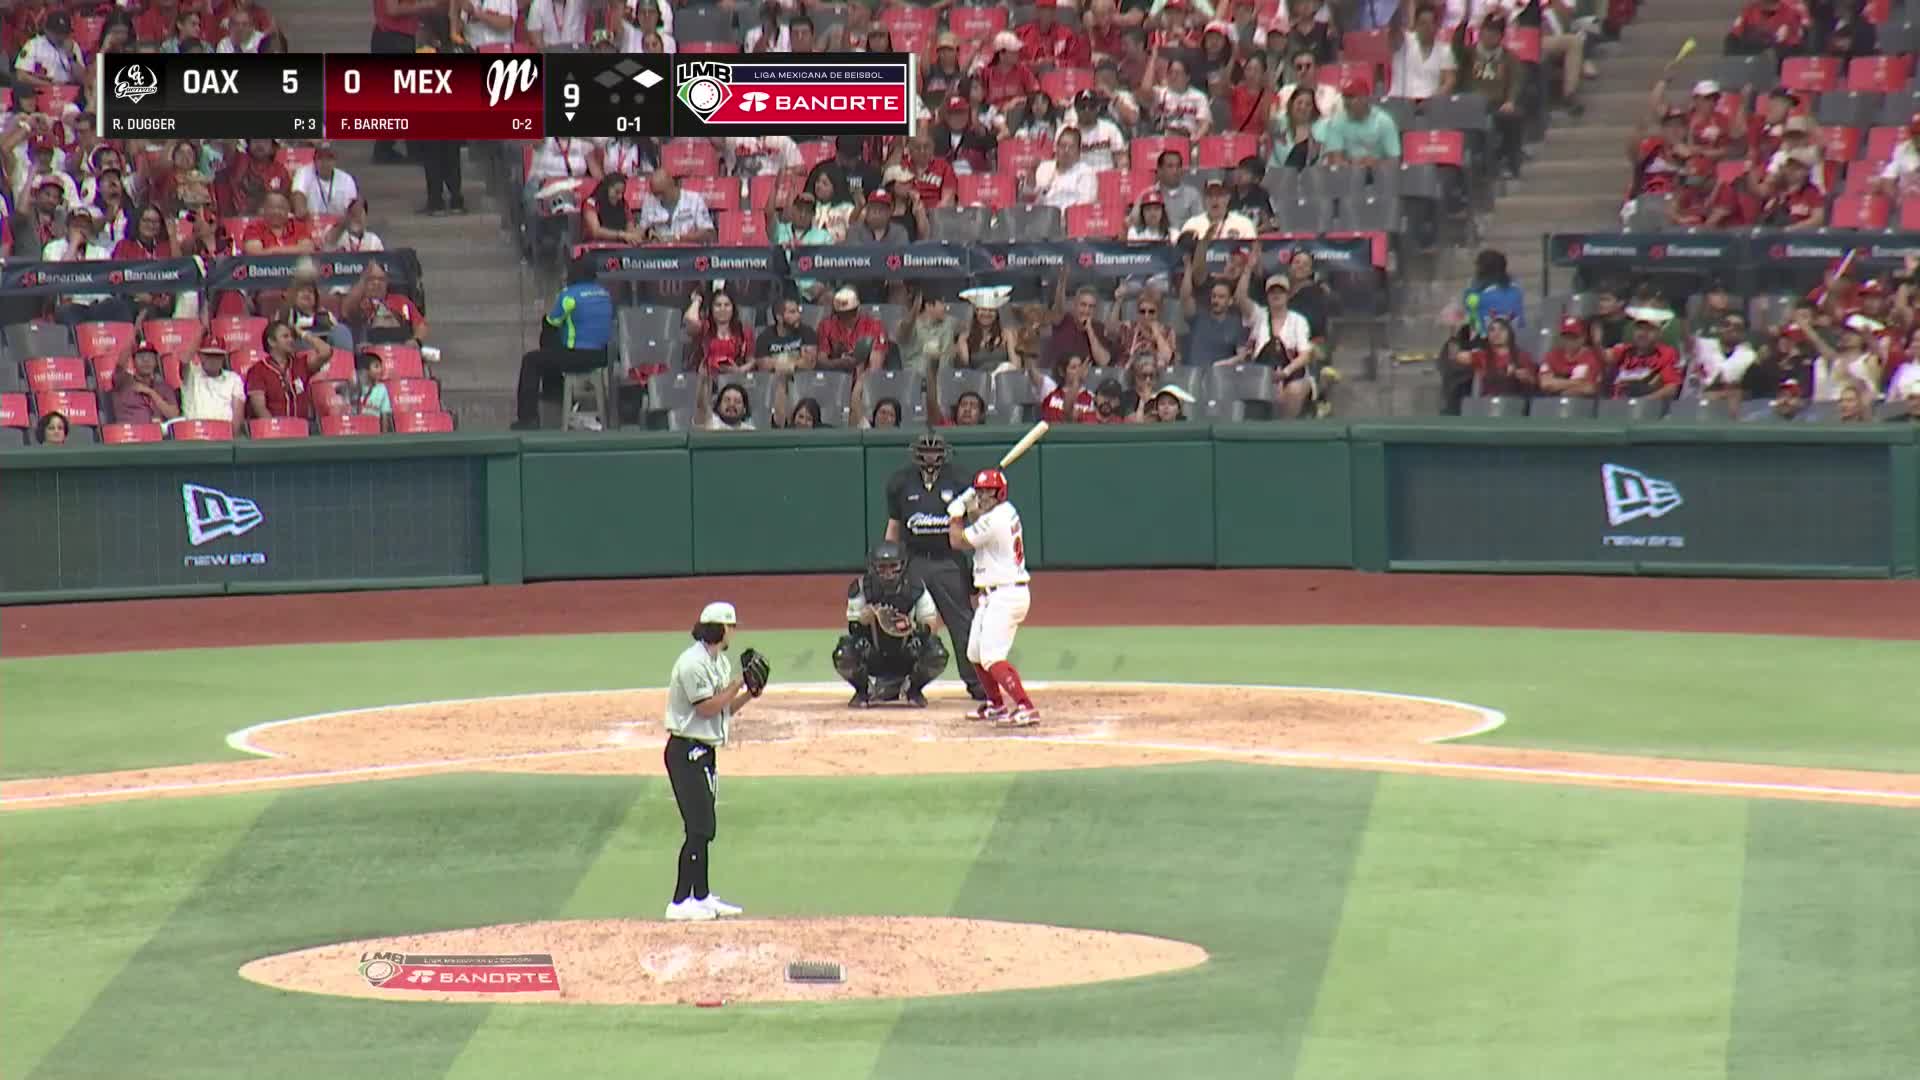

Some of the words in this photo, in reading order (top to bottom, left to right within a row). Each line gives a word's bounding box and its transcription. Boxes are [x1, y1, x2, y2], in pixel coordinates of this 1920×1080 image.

[711, 256, 768, 269] Banamex
[814, 255, 871, 268] Banamex
[903, 254, 960, 267] Banamex
[1007, 253, 1064, 266] Banamex
[1095, 252, 1152, 265] Banamex
[124, 268, 180, 282] Banamex
[439, 972, 553, 984] BANORTE
